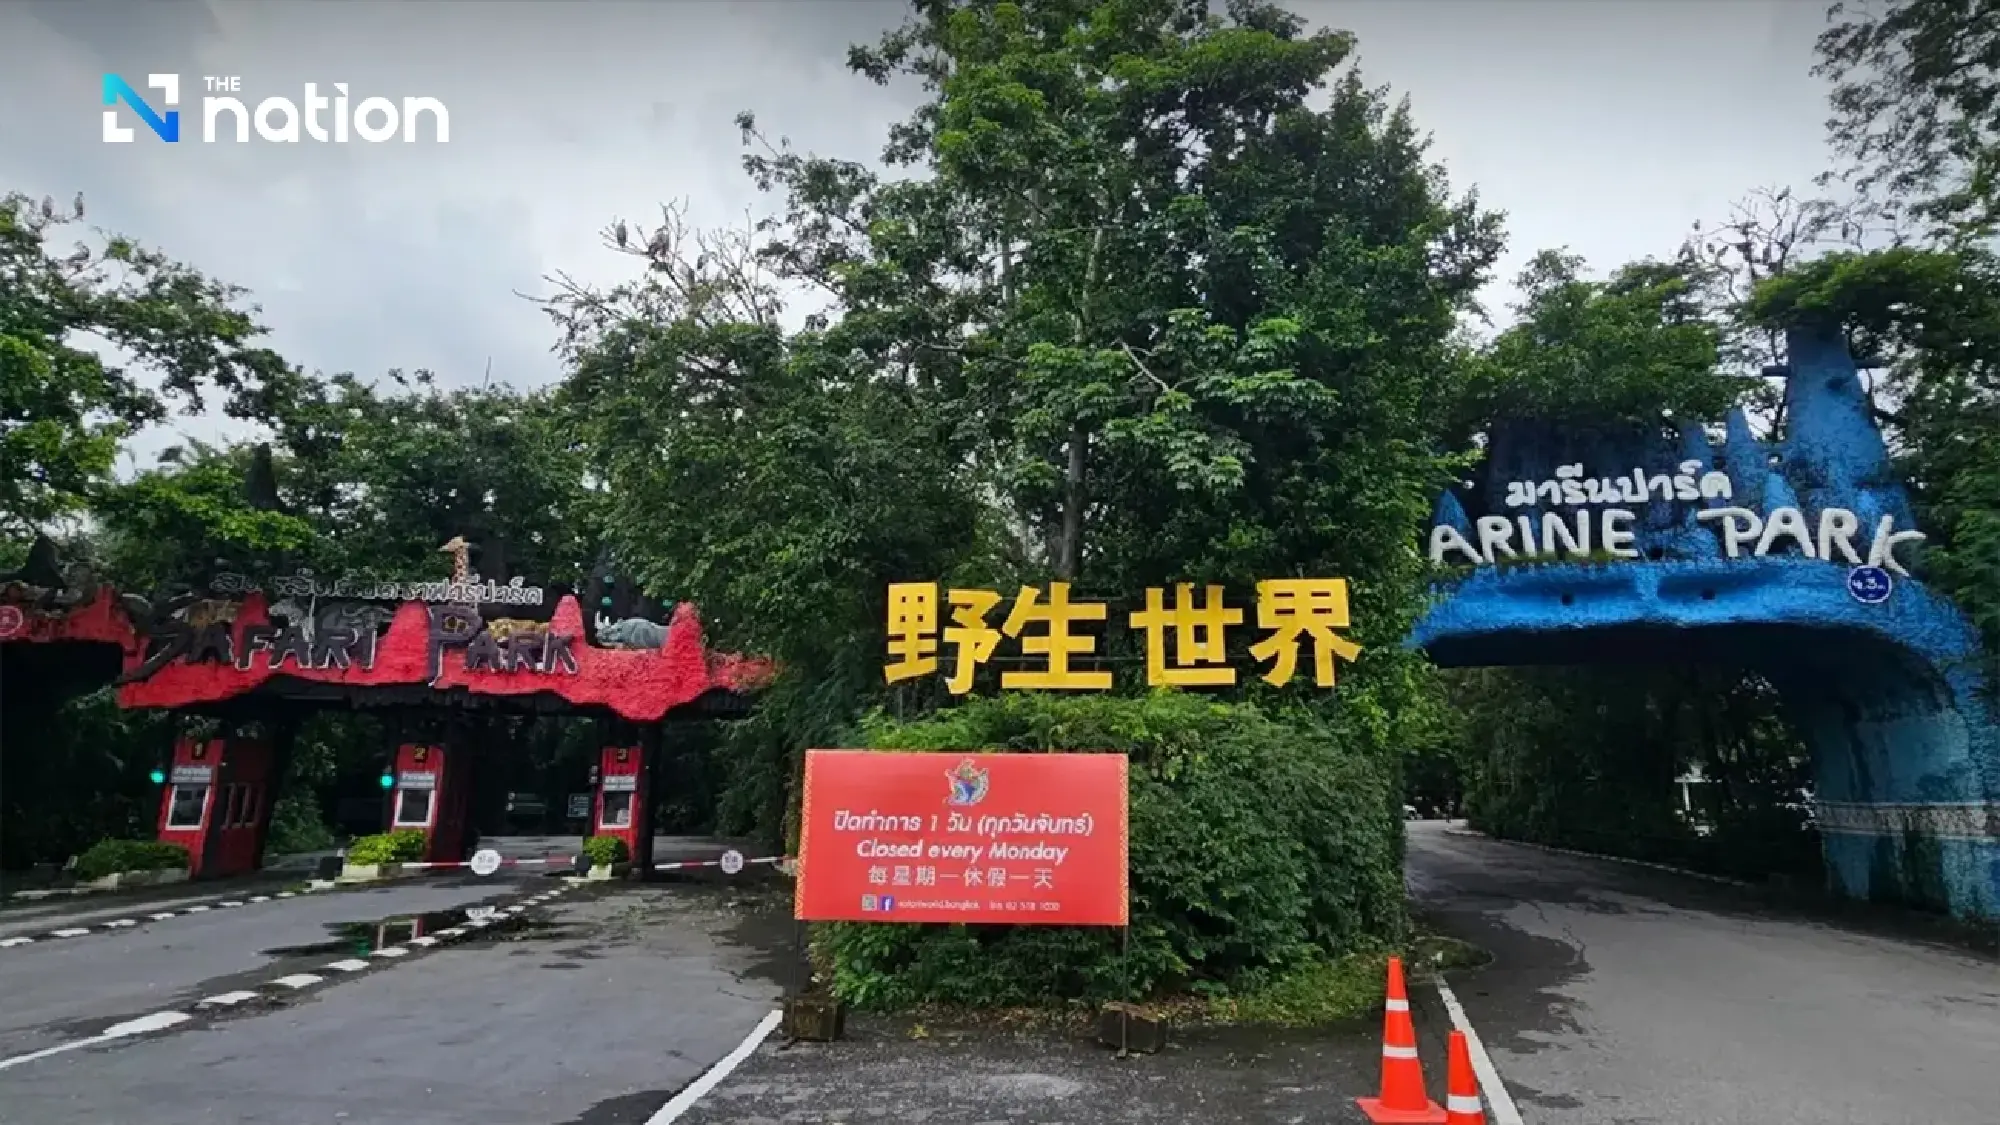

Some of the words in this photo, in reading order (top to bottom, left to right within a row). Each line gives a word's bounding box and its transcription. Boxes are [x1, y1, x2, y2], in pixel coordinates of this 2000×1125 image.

[1505, 459, 1733, 506] มารีนปาร์ค
[1697, 507, 1927, 577] PARK
[112, 593, 375, 687] SAFARI
[427, 604, 578, 687] PARK
[884, 578, 1364, 695] 野生世界
[834, 810, 921, 832] ปิดทำการ
[930, 815, 938, 832] 1
[947, 813, 972, 832] วัน
[978, 811, 1095, 838] (ทุกวันจันทร์)
[857, 838, 923, 858] Closed
[928, 842, 983, 864] every
[989, 842, 1069, 865] Monday
[868, 865, 1054, 888] 每星期一休假一天
